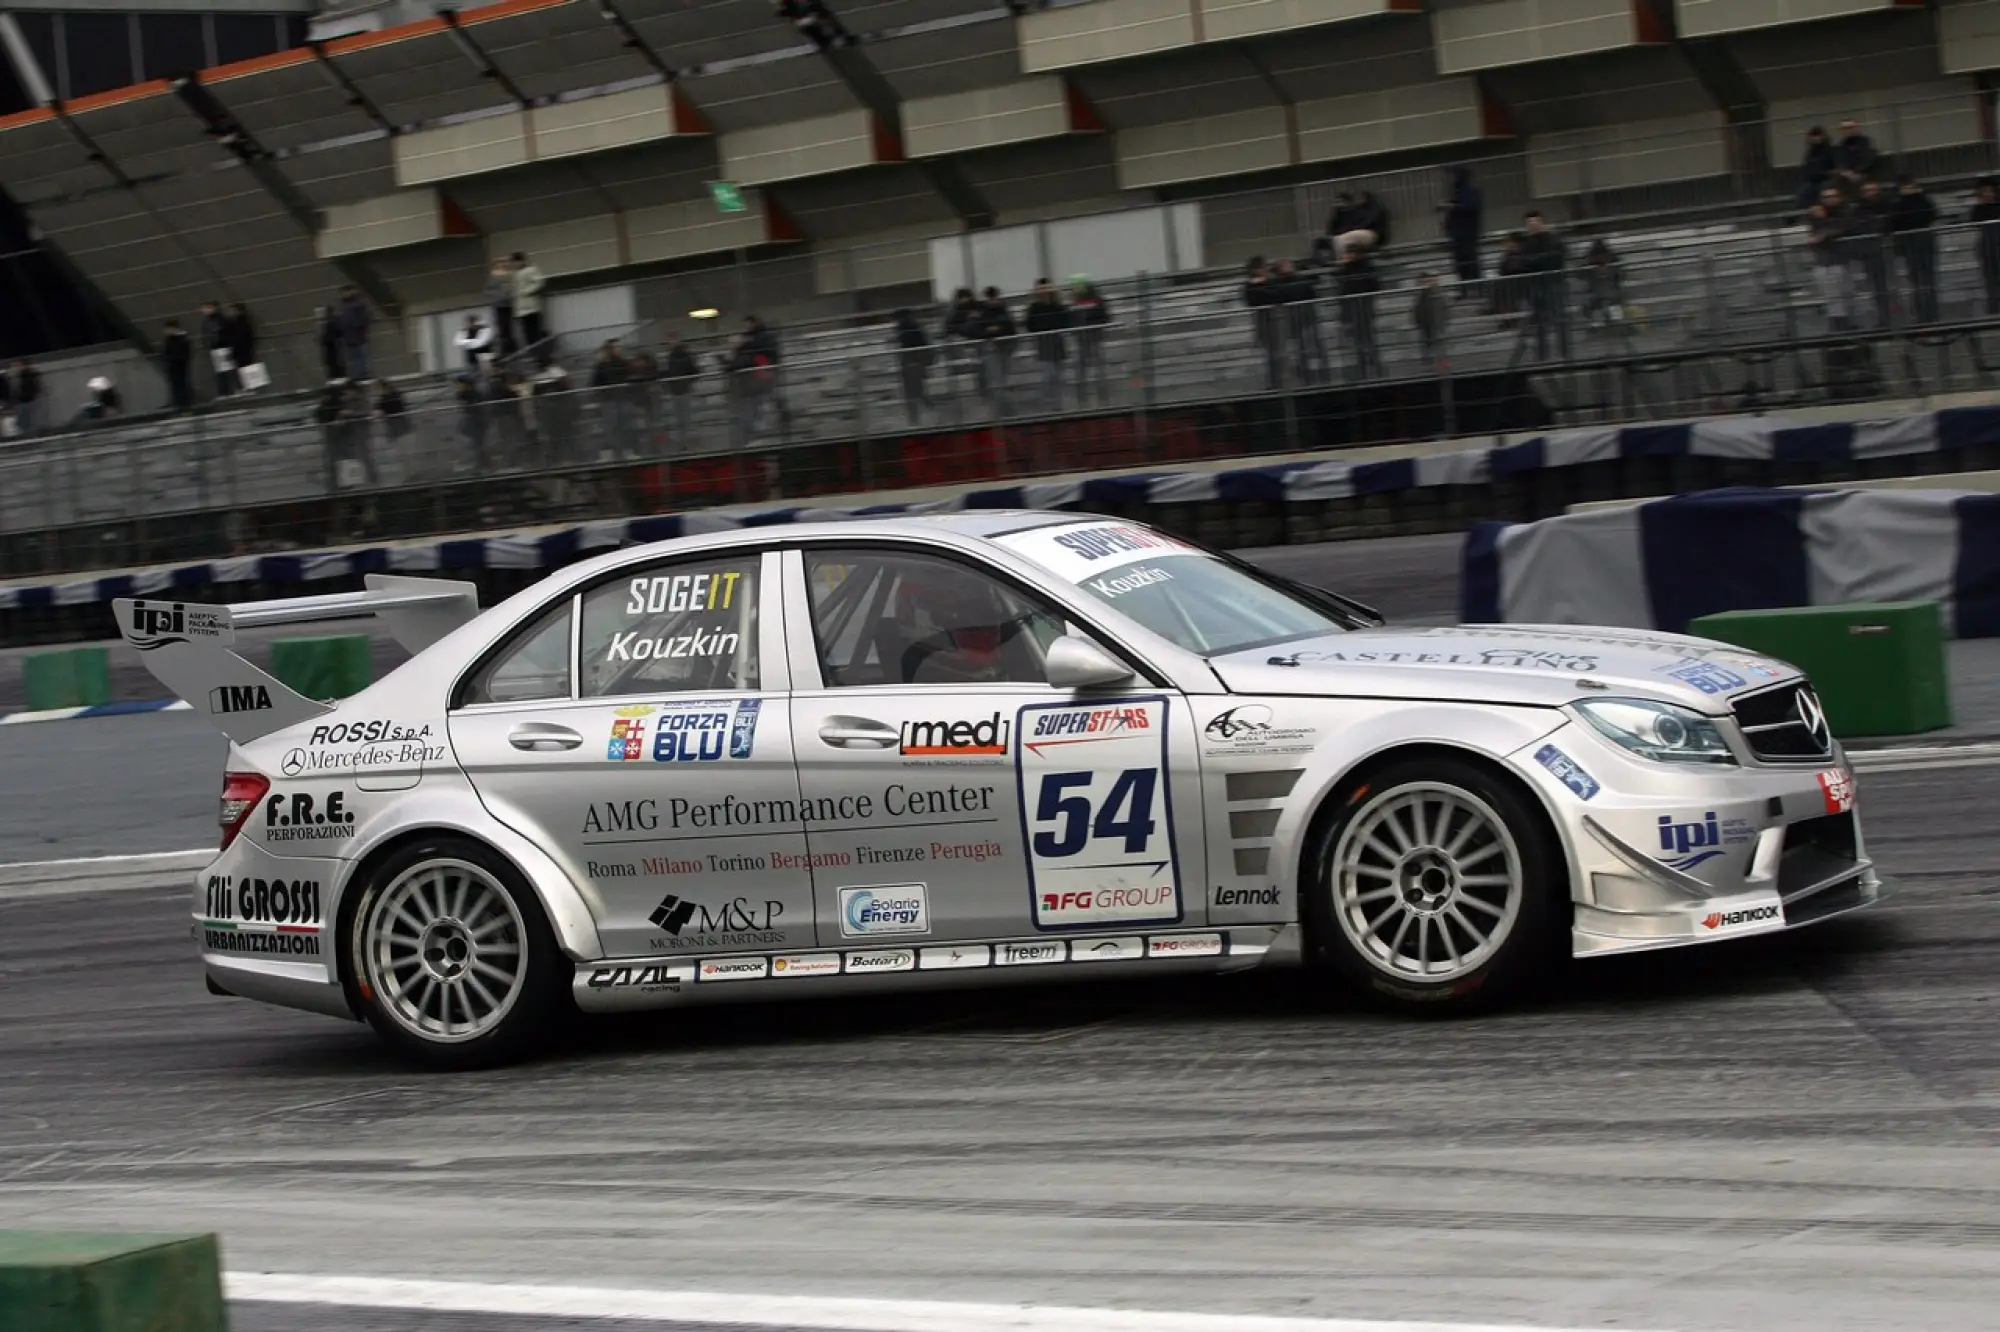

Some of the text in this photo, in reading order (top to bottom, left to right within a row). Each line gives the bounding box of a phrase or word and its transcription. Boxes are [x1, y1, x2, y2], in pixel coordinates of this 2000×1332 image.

[626, 573, 741, 614] SOGEIT
[1090, 566, 1174, 598] Kouzkin
[606, 625, 739, 661] Kouzkin
[220, 684, 273, 712] IMA
[309, 719, 391, 746] ROSSI
[657, 713, 728, 731] FORZA
[1034, 706, 1150, 736] SUPERSTARS
[306, 743, 446, 770] Mercedes-Benz
[653, 730, 725, 762] BLU
[266, 791, 355, 827] F.R.E.
[582, 784, 995, 834] AMG Performance Center
[1033, 767, 1159, 858] 54
[266, 825, 356, 842] PERFORAZIONI
[587, 839, 1003, 879] Roma Milano Torino Bergamo Firenze Perugia
[238, 877, 320, 924] GROSSI
[871, 897, 919, 911] Solaria
[1061, 886, 1173, 910] FG GROUP
[1215, 884, 1281, 906] Lennok
[698, 896, 784, 934] M&P
[860, 908, 919, 924] Energy
[205, 930, 320, 955] URBANIZZAZIONI
[650, 935, 704, 950] MORONI
[721, 931, 787, 945] PARTNERS
